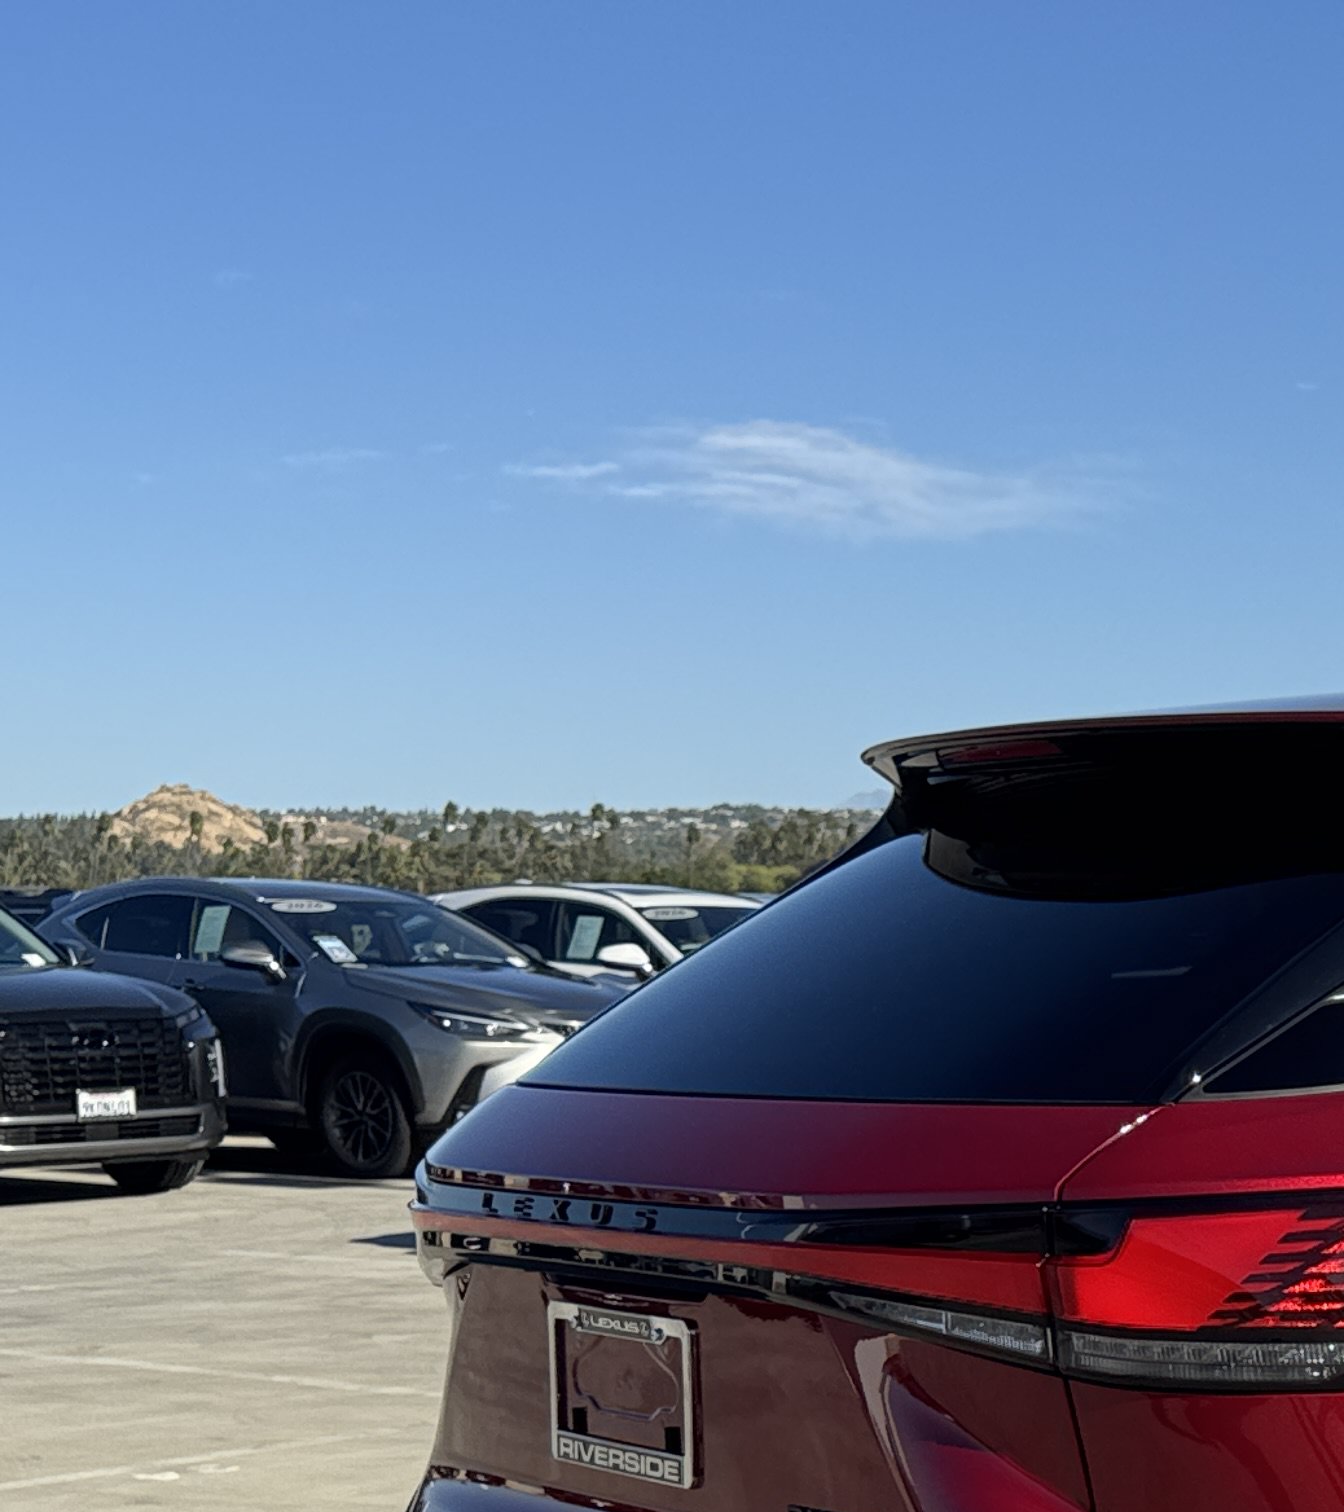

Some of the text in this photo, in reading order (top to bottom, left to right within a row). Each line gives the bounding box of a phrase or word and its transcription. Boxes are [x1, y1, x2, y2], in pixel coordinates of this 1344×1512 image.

[481, 1192, 659, 1232] LEXUS
[589, 1315, 640, 1334] LEXUS
[558, 1436, 680, 1482] RIVERSIDE
